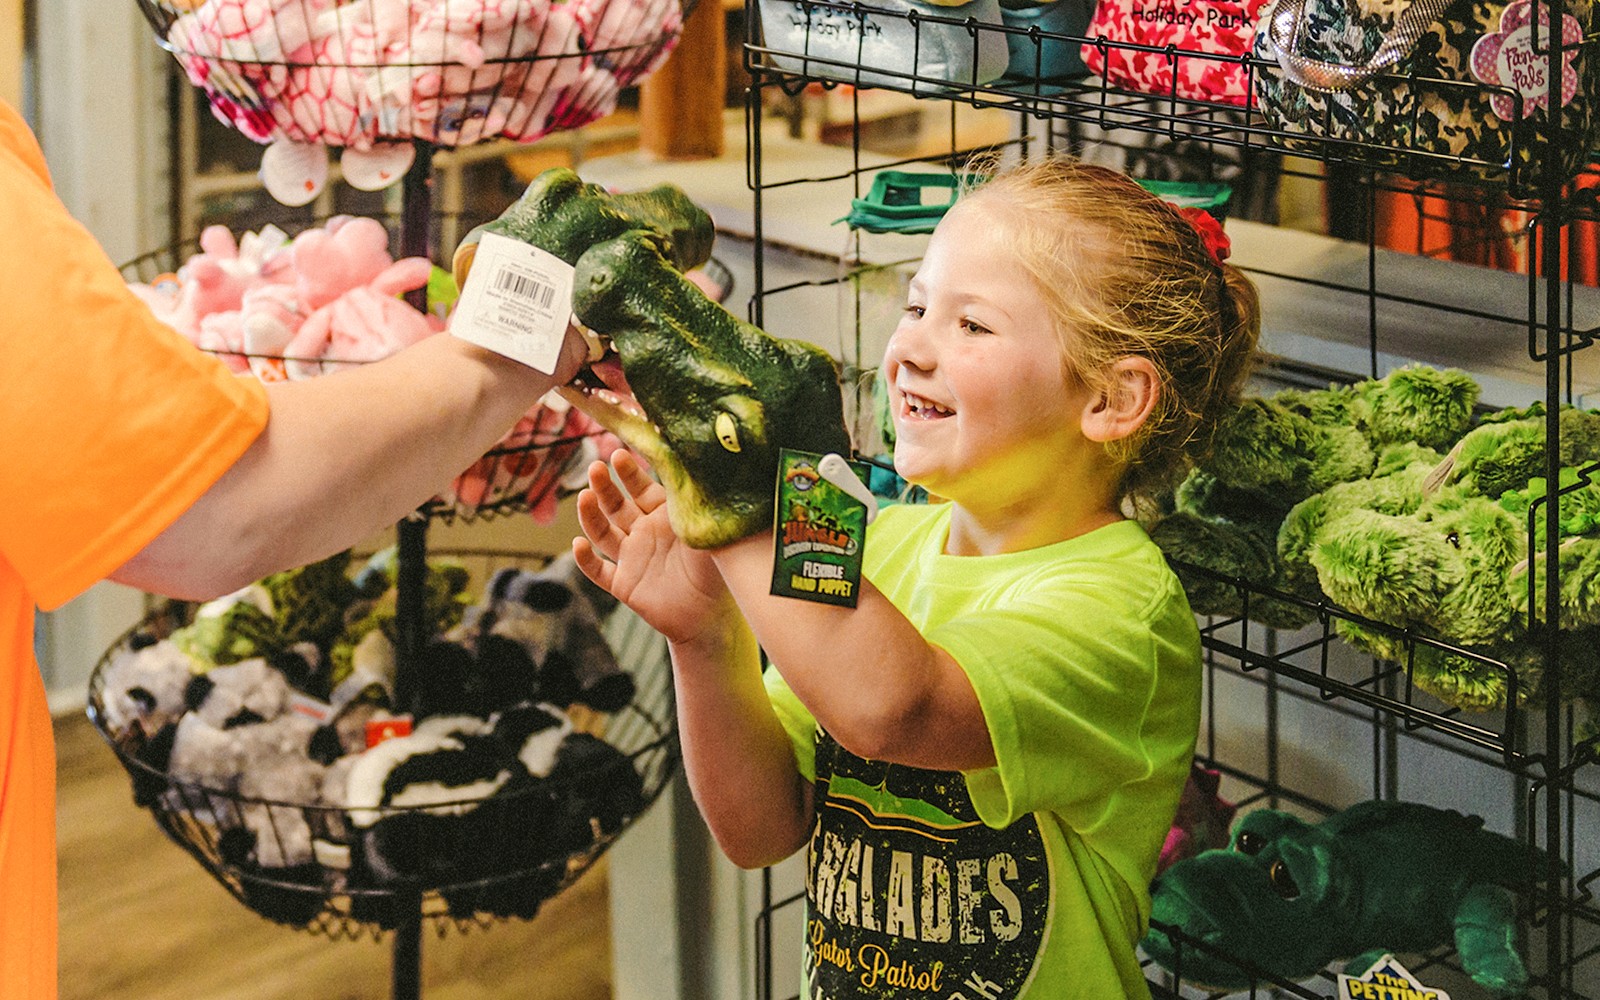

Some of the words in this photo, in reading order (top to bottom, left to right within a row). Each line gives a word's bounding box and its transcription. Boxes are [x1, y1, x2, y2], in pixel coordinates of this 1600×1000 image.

[1131, 3, 1198, 31] Holiday
[1206, 8, 1253, 28] Park
[846, 19, 883, 38] Prk
[1512, 64, 1545, 91] Pals
[498, 315, 533, 334] WARNING
[803, 561, 844, 579] FLEXIBLE
[817, 578, 853, 597] PUPPET
[808, 919, 856, 973] Gator
[858, 943, 943, 992] Patrol
[1374, 973, 1410, 989] The
